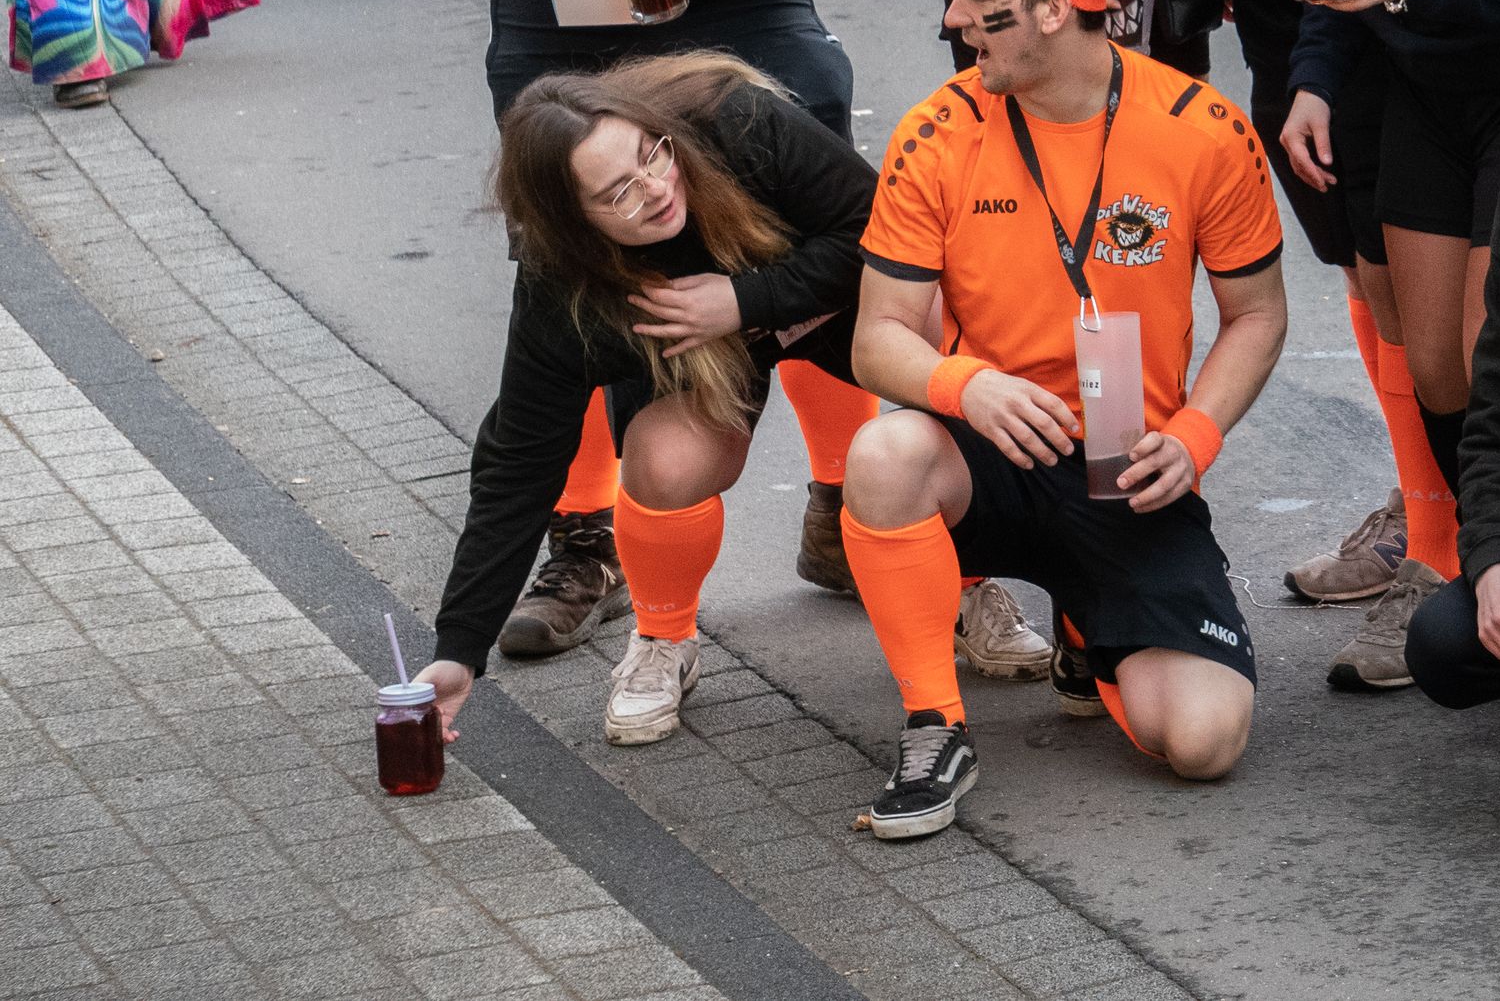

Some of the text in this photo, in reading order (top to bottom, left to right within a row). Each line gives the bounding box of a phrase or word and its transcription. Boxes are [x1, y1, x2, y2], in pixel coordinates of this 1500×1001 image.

[973, 199, 1018, 214] JAKO
[1094, 239, 1168, 267] KERLE
[1200, 619, 1238, 647] JAKO
